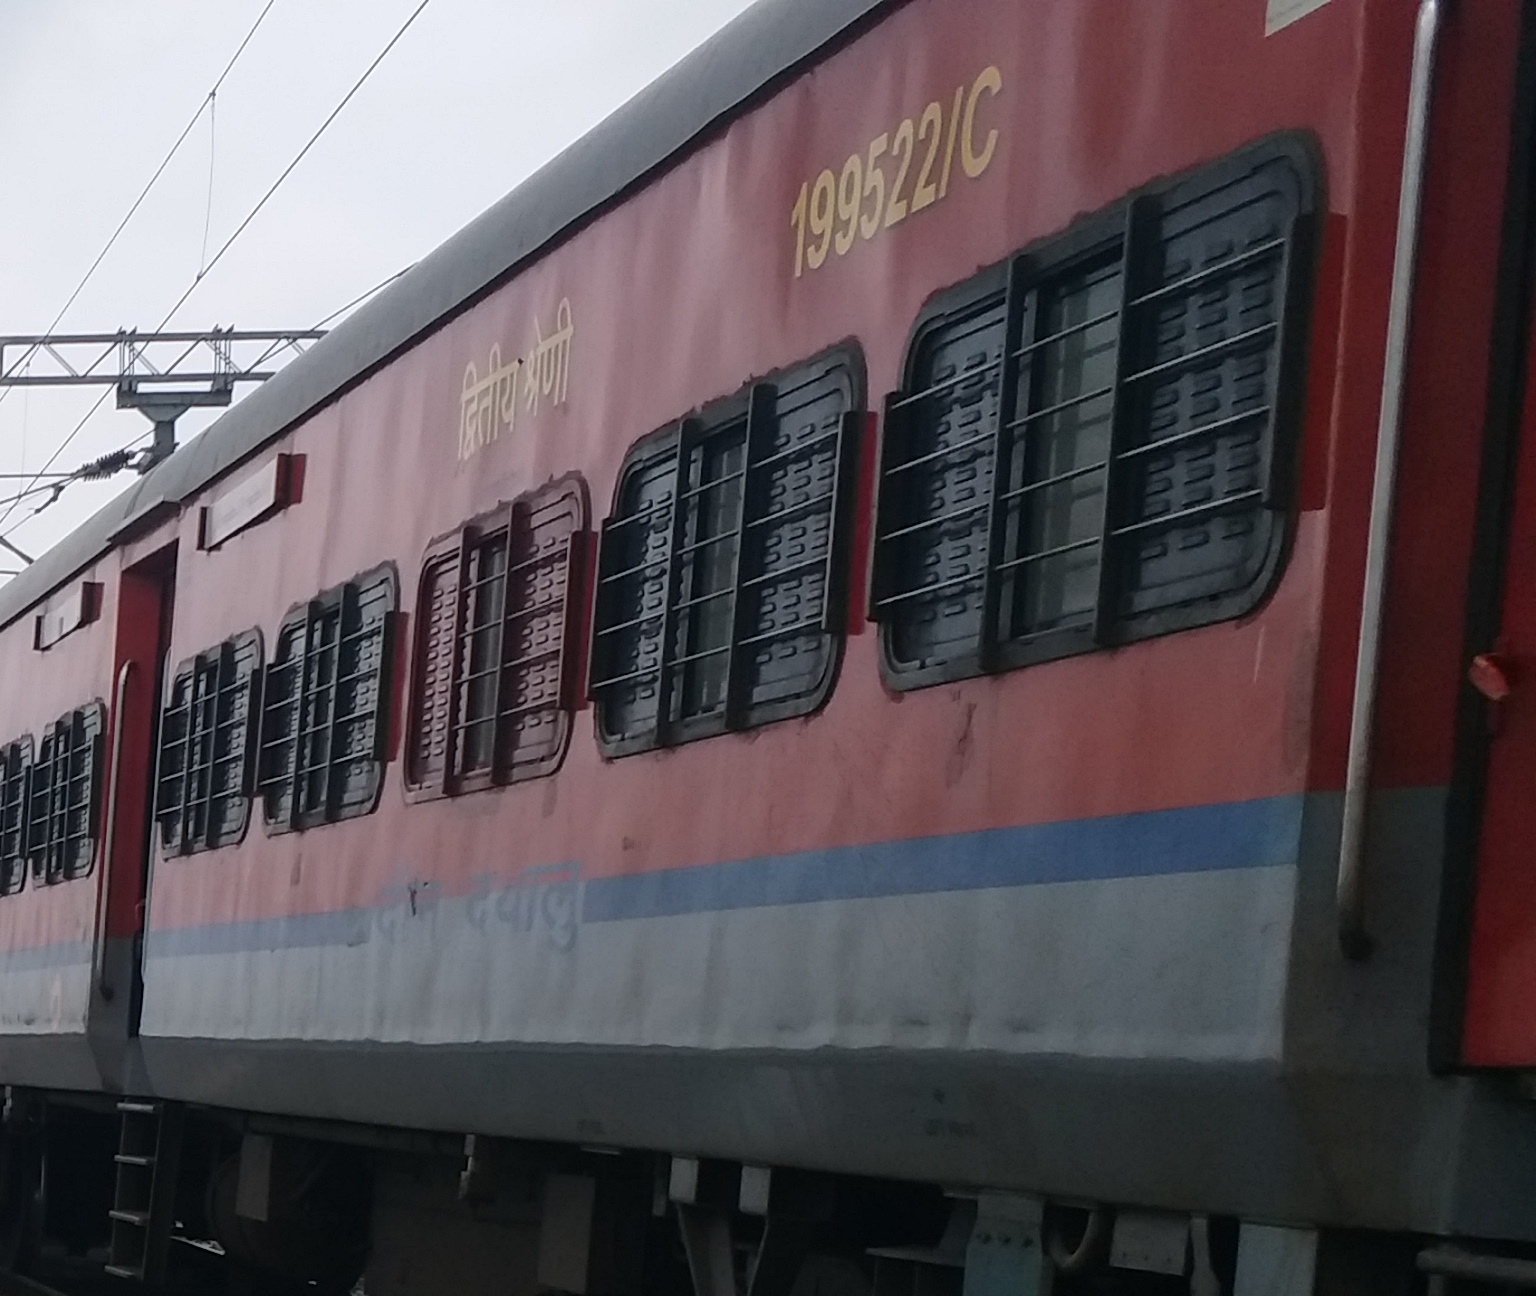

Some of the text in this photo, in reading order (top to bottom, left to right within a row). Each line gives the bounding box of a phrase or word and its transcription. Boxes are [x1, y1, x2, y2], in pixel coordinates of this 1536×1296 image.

[791, 66, 1002, 279] 199522/C
[458, 296, 574, 461] द्वितीय श्रेणी
